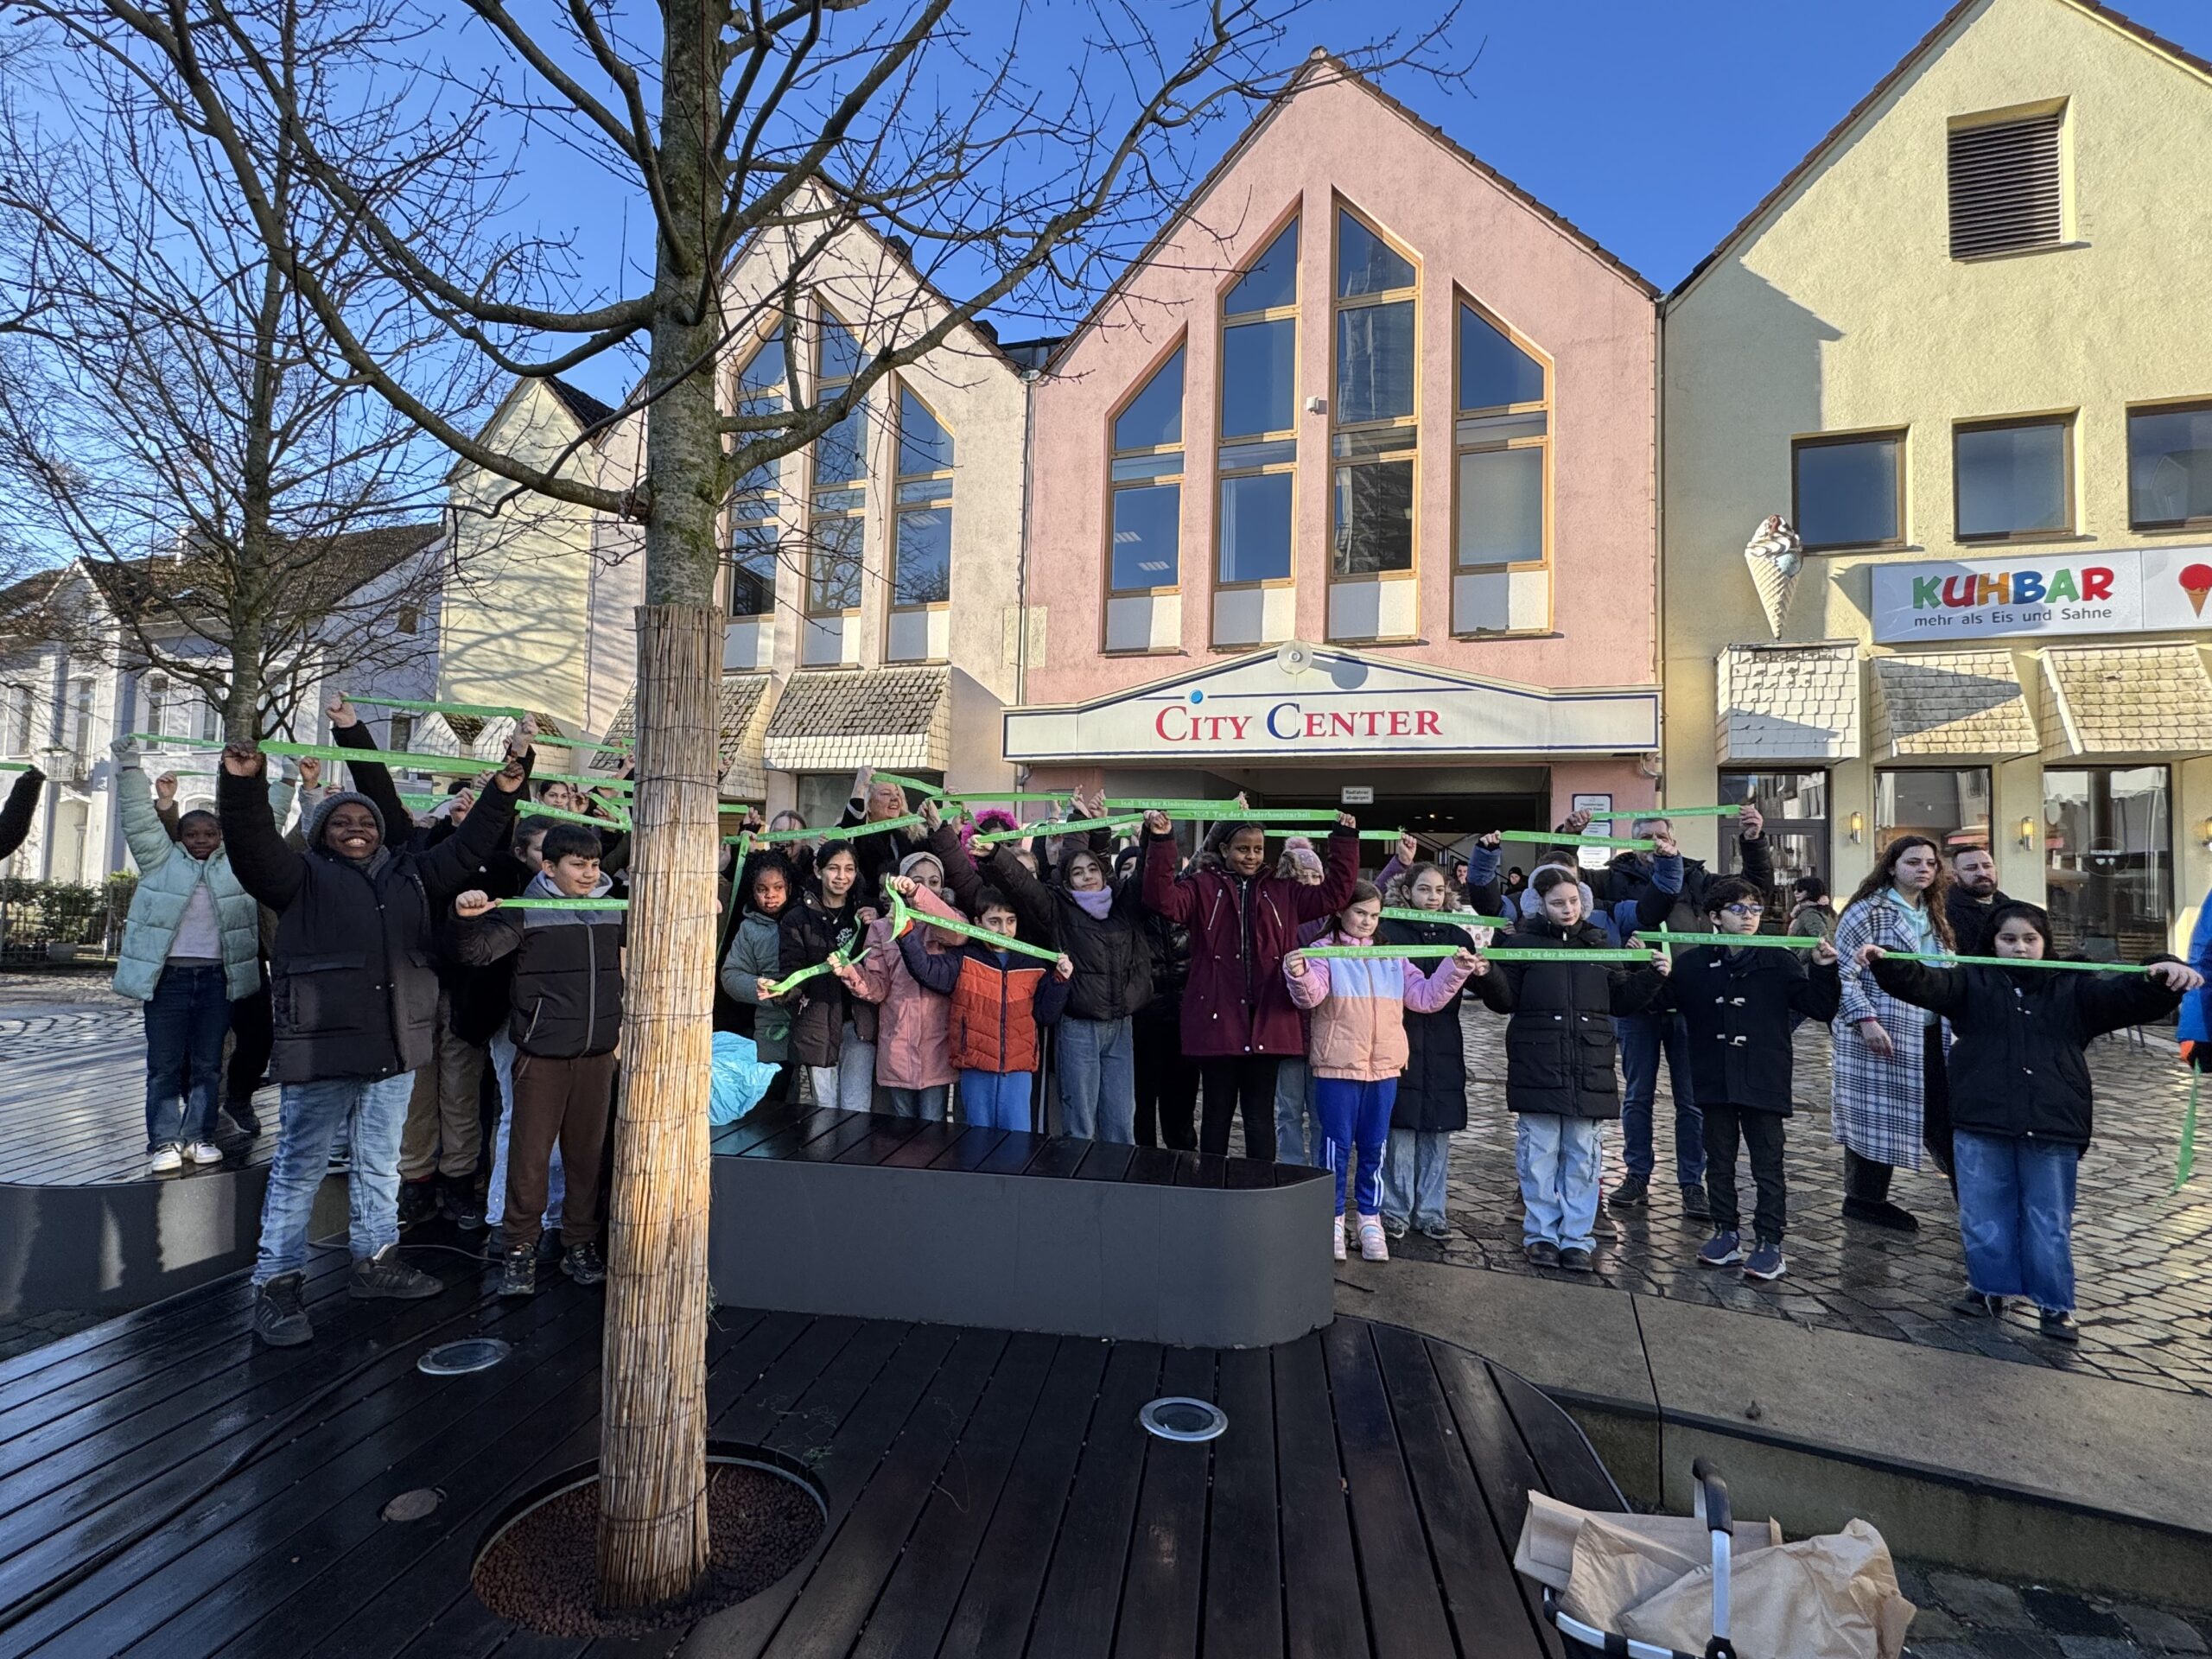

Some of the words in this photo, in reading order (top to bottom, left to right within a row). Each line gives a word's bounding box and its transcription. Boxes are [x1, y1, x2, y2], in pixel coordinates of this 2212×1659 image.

[1912, 567, 2114, 609] KUHBAR
[1914, 613, 1953, 627] mehr
[1961, 611, 1983, 624] als
[1993, 610, 2013, 623] Eis
[2023, 609, 2051, 622] und
[2062, 607, 2112, 620] Sahne
[1022, 828, 1035, 837] Tag
[1052, 817, 1120, 832] Kinderhospizarbeit
[1392, 910, 1406, 918] Tag
[939, 917, 953, 929] Tag
[954, 921, 968, 931] der
[969, 925, 1036, 954] Kinderhospizarbeit
[1344, 948, 1357, 957] Tag
[1527, 951, 1541, 960] Tag
[1558, 950, 1633, 960] Kinderhospizarbeit
